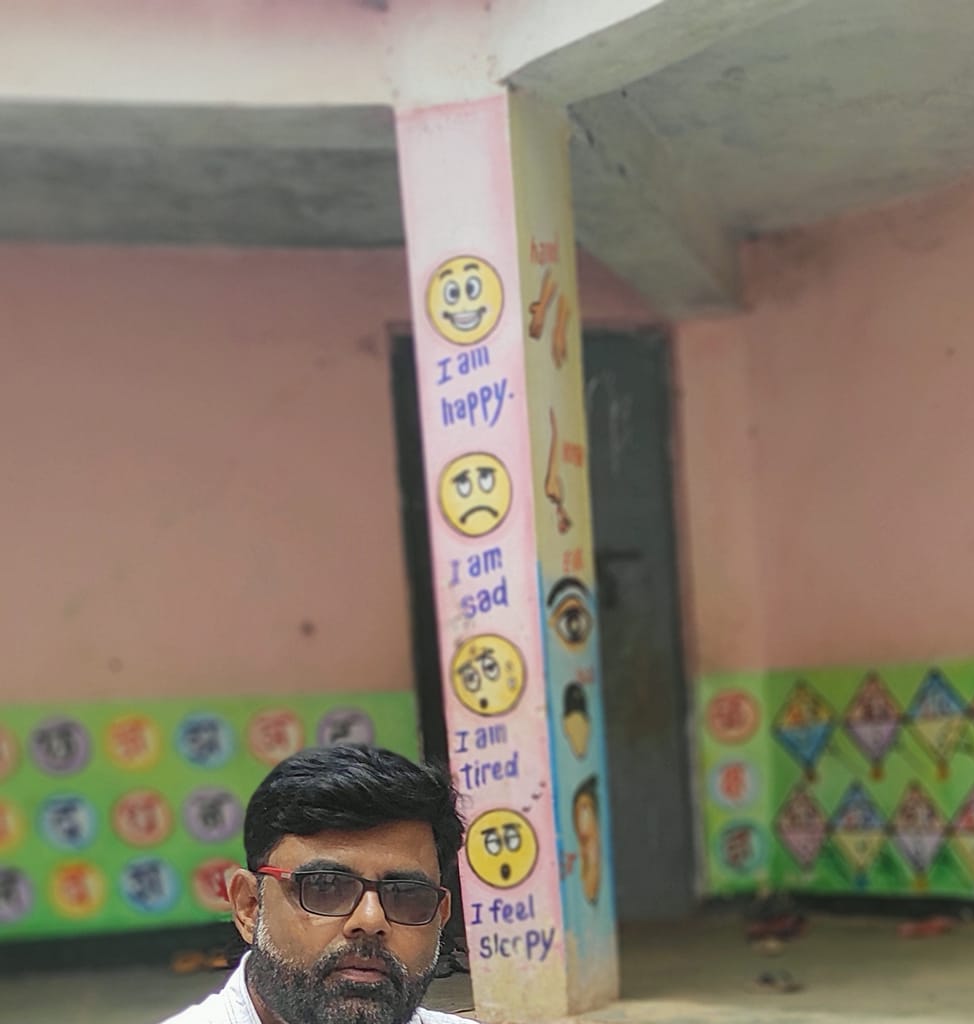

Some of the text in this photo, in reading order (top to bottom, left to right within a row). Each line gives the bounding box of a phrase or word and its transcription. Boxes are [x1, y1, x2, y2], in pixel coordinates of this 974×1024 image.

[437, 345, 490, 385] I am
[450, 546, 502, 587] I am
[460, 574, 508, 620] sad
[453, 724, 507, 753] I am
[459, 751, 519, 790] tired
[471, 894, 535, 925] I feel
